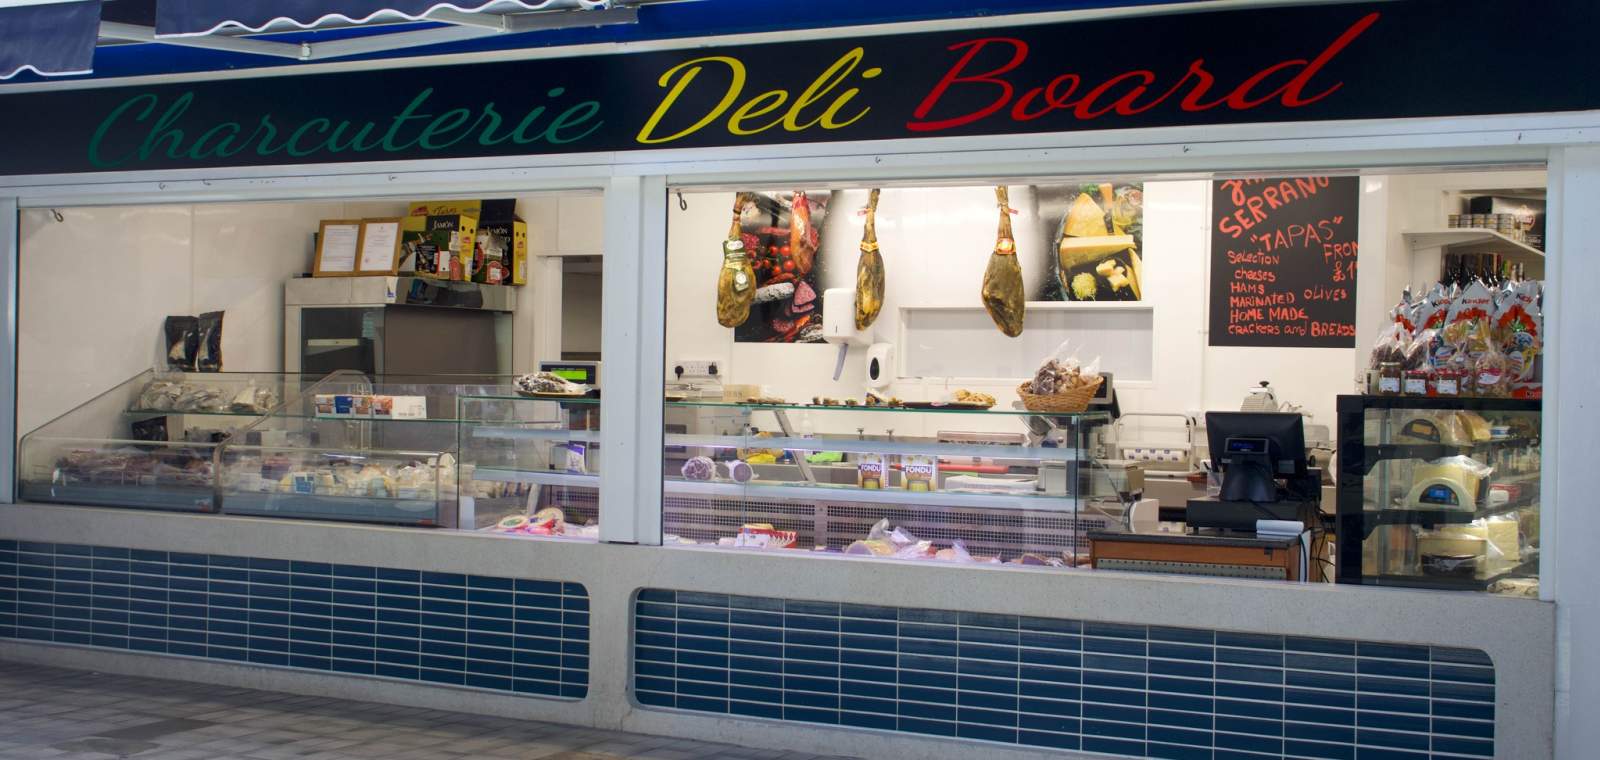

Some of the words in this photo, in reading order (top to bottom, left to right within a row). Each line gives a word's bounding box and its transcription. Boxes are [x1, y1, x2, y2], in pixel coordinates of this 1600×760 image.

[88, 87, 602, 169] Charcuterie
[636, 47, 881, 144] Deli
[906, 12, 1378, 132] Board
[1230, 282, 1265, 296] HAMS
[1230, 309, 1265, 323] HOME
[1268, 307, 1309, 321] MADE
[905, 465, 932, 474] FONDU
